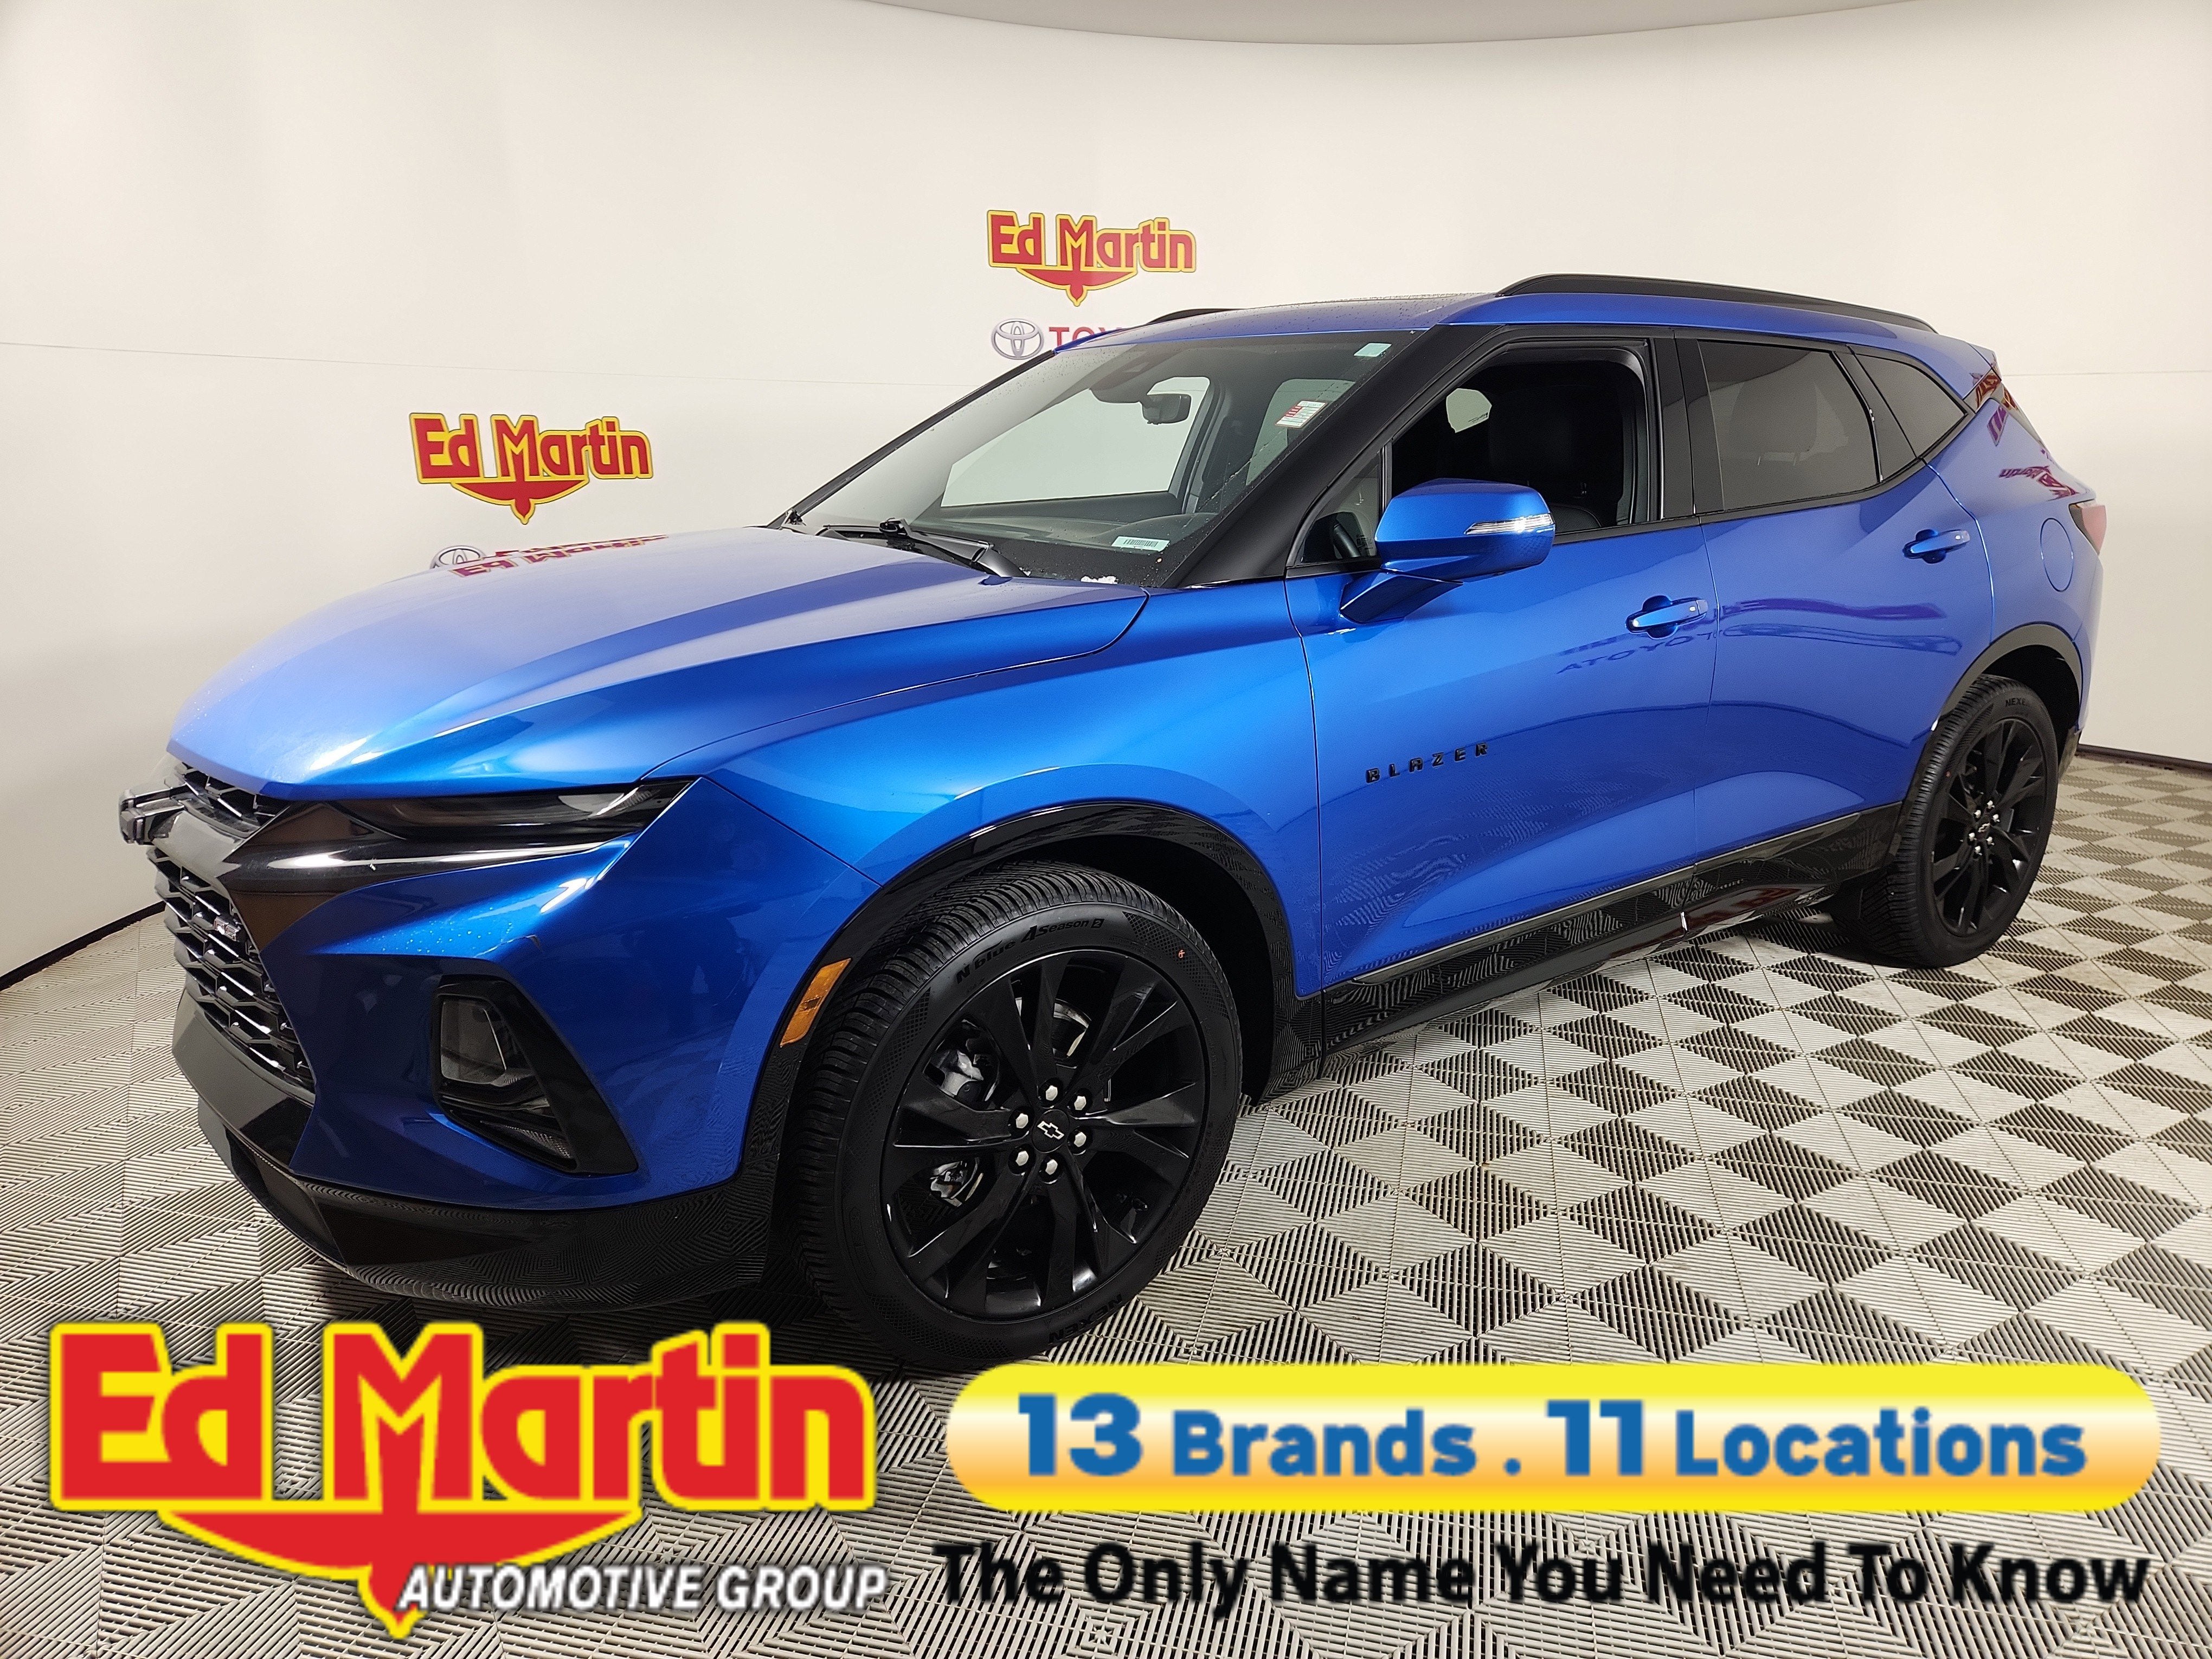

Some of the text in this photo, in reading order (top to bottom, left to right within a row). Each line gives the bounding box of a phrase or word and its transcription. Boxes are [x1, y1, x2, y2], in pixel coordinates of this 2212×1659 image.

[990, 213, 1193, 269] Ed Martin
[412, 415, 651, 480] Ed Martin
[1366, 742, 1488, 783] BLAZER
[1048, 1293, 1123, 1345] NEXEN
